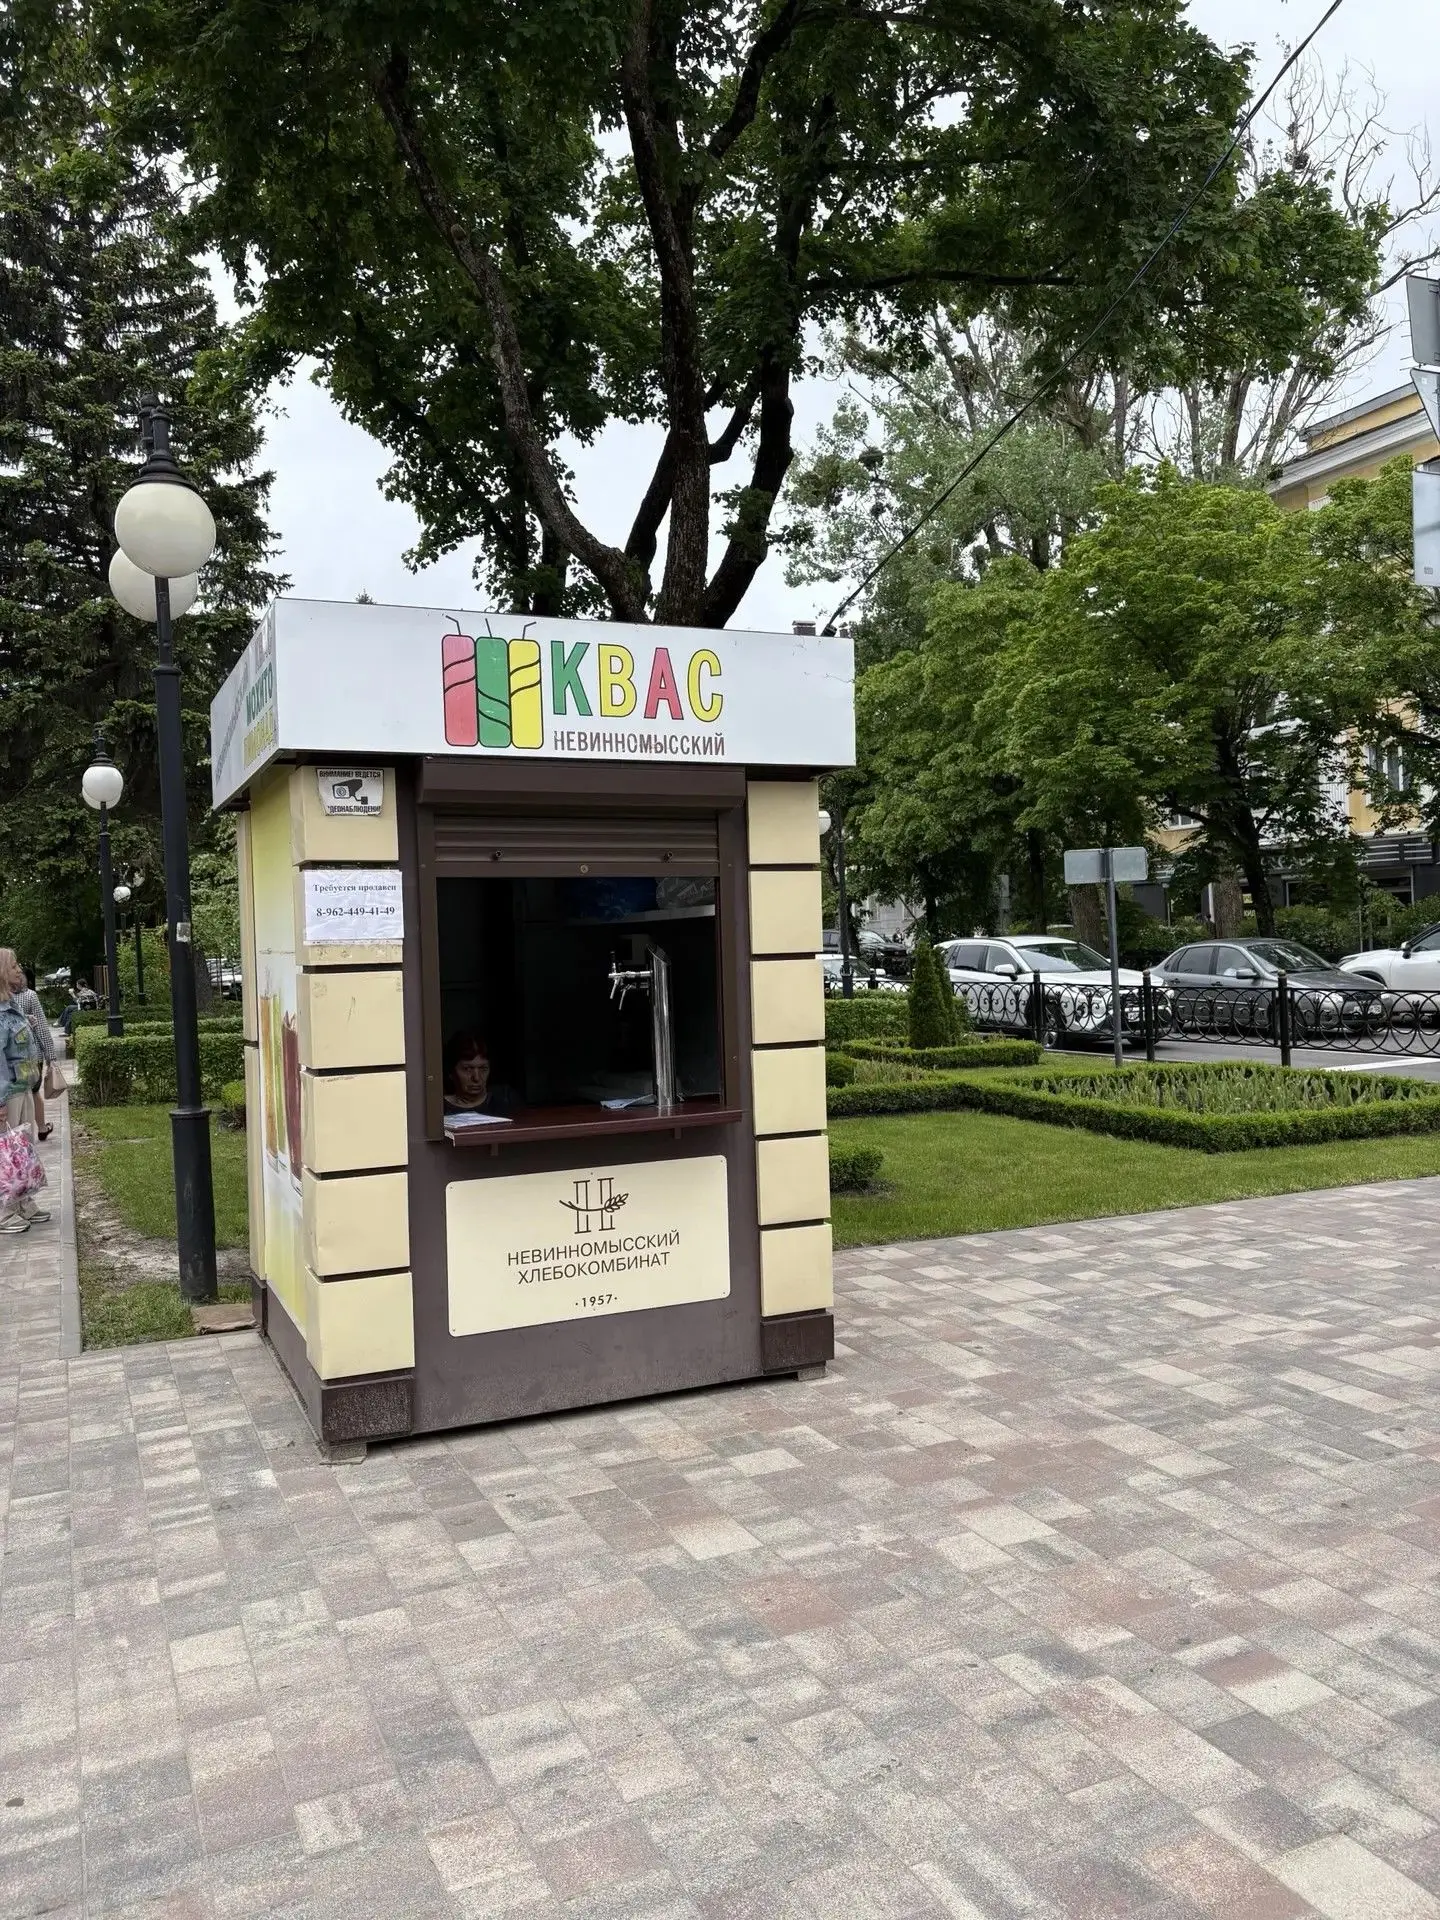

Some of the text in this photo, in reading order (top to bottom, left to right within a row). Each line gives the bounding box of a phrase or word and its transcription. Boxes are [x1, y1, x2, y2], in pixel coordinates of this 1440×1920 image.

[551, 640, 724, 723] КВАС
[554, 731, 725, 755] НЕВИННОМЫССКИЙ
[319, 770, 354, 778] ВНИМАНИЕ!
[313, 884, 356, 894] Требуется
[316, 906, 395, 917] 8-962-449-41-49
[508, 1230, 680, 1266] НЕВИННОМЫССКИЙ
[518, 1251, 671, 1285] ХЛЕБОКОМБИНАТ
